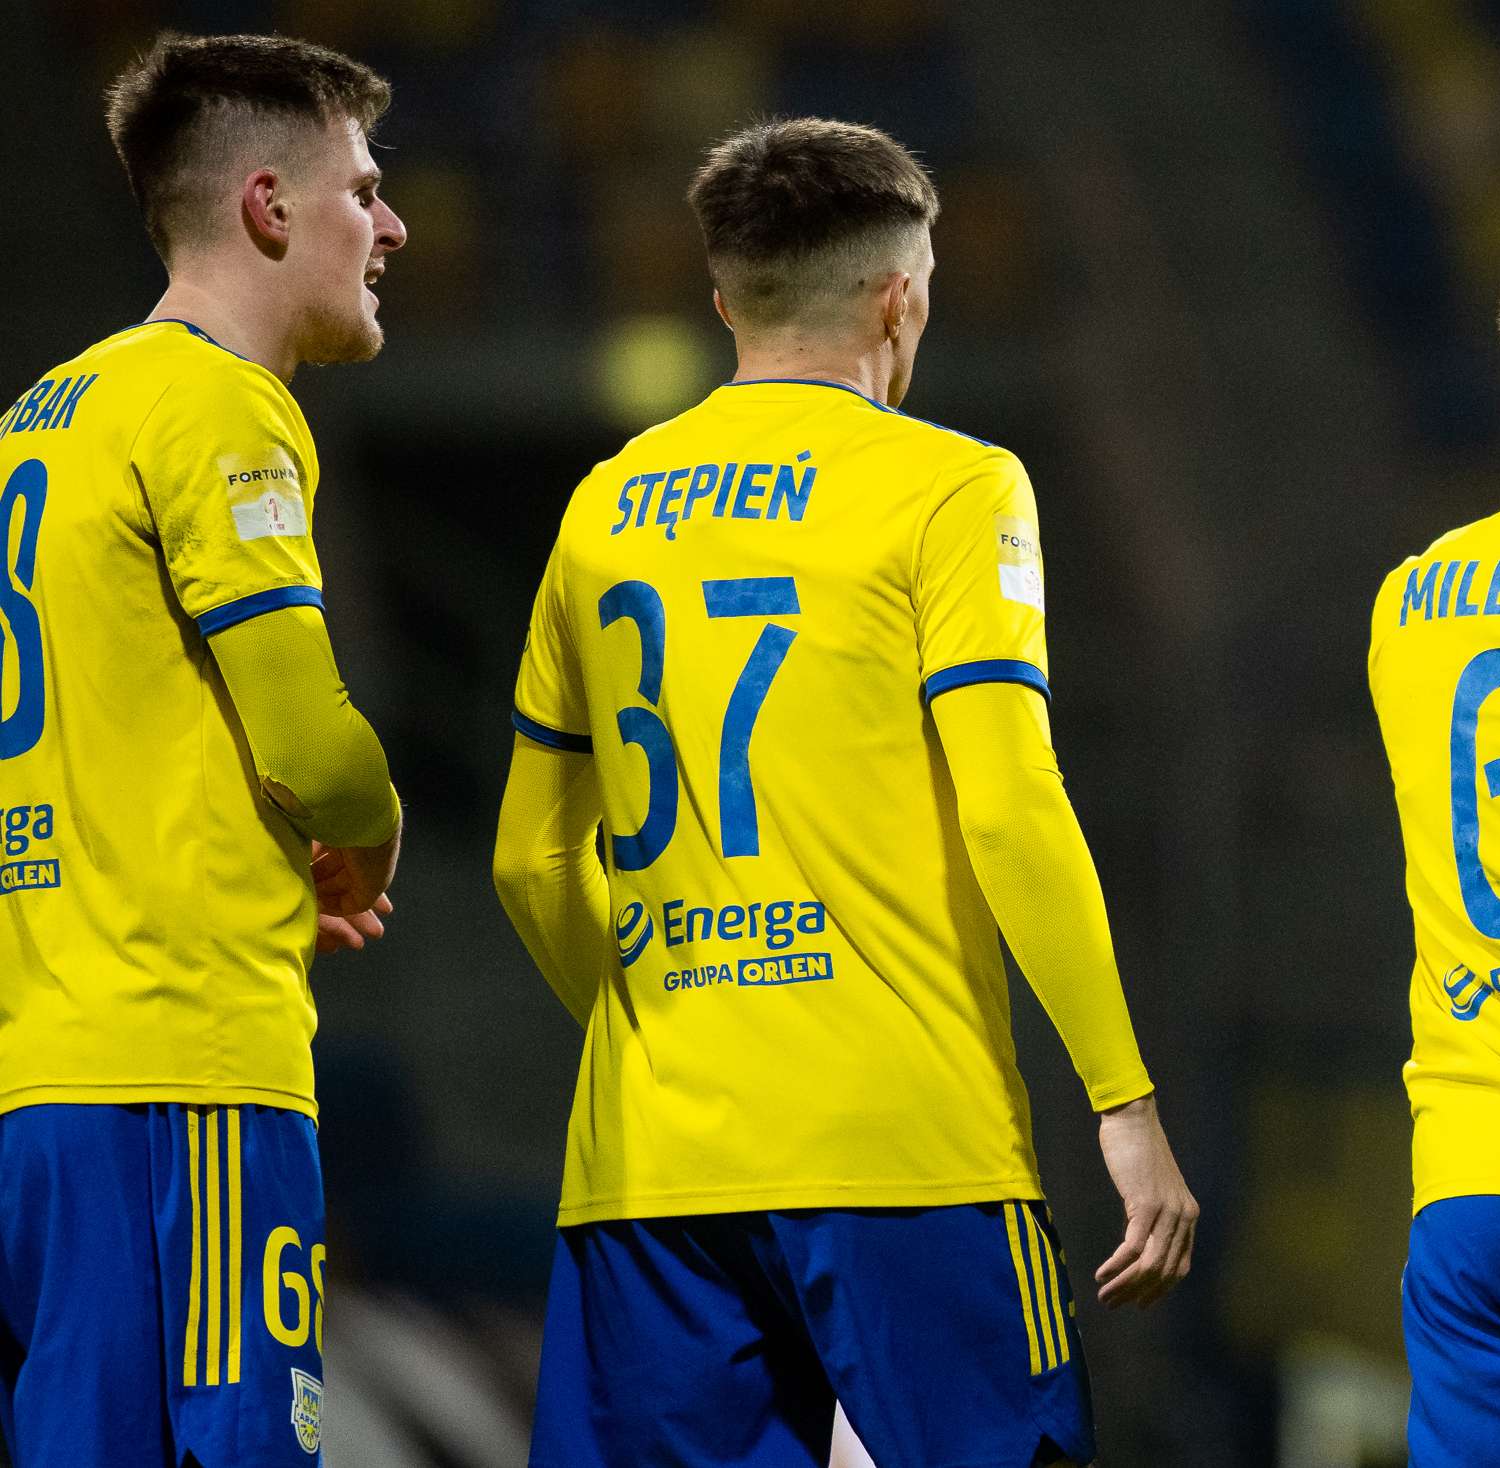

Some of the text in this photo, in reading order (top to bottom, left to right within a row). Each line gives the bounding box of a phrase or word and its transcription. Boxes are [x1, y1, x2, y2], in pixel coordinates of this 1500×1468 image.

[0, 373, 99, 440] BAK
[228, 468, 294, 486] FORTUNA
[611, 449, 816, 541] STĘPIEŃ
[599, 577, 801, 871] 37
[1, 863, 55, 890] OLEN
[663, 899, 826, 951] Energa
[664, 955, 828, 991] GRUPA ORLEN
